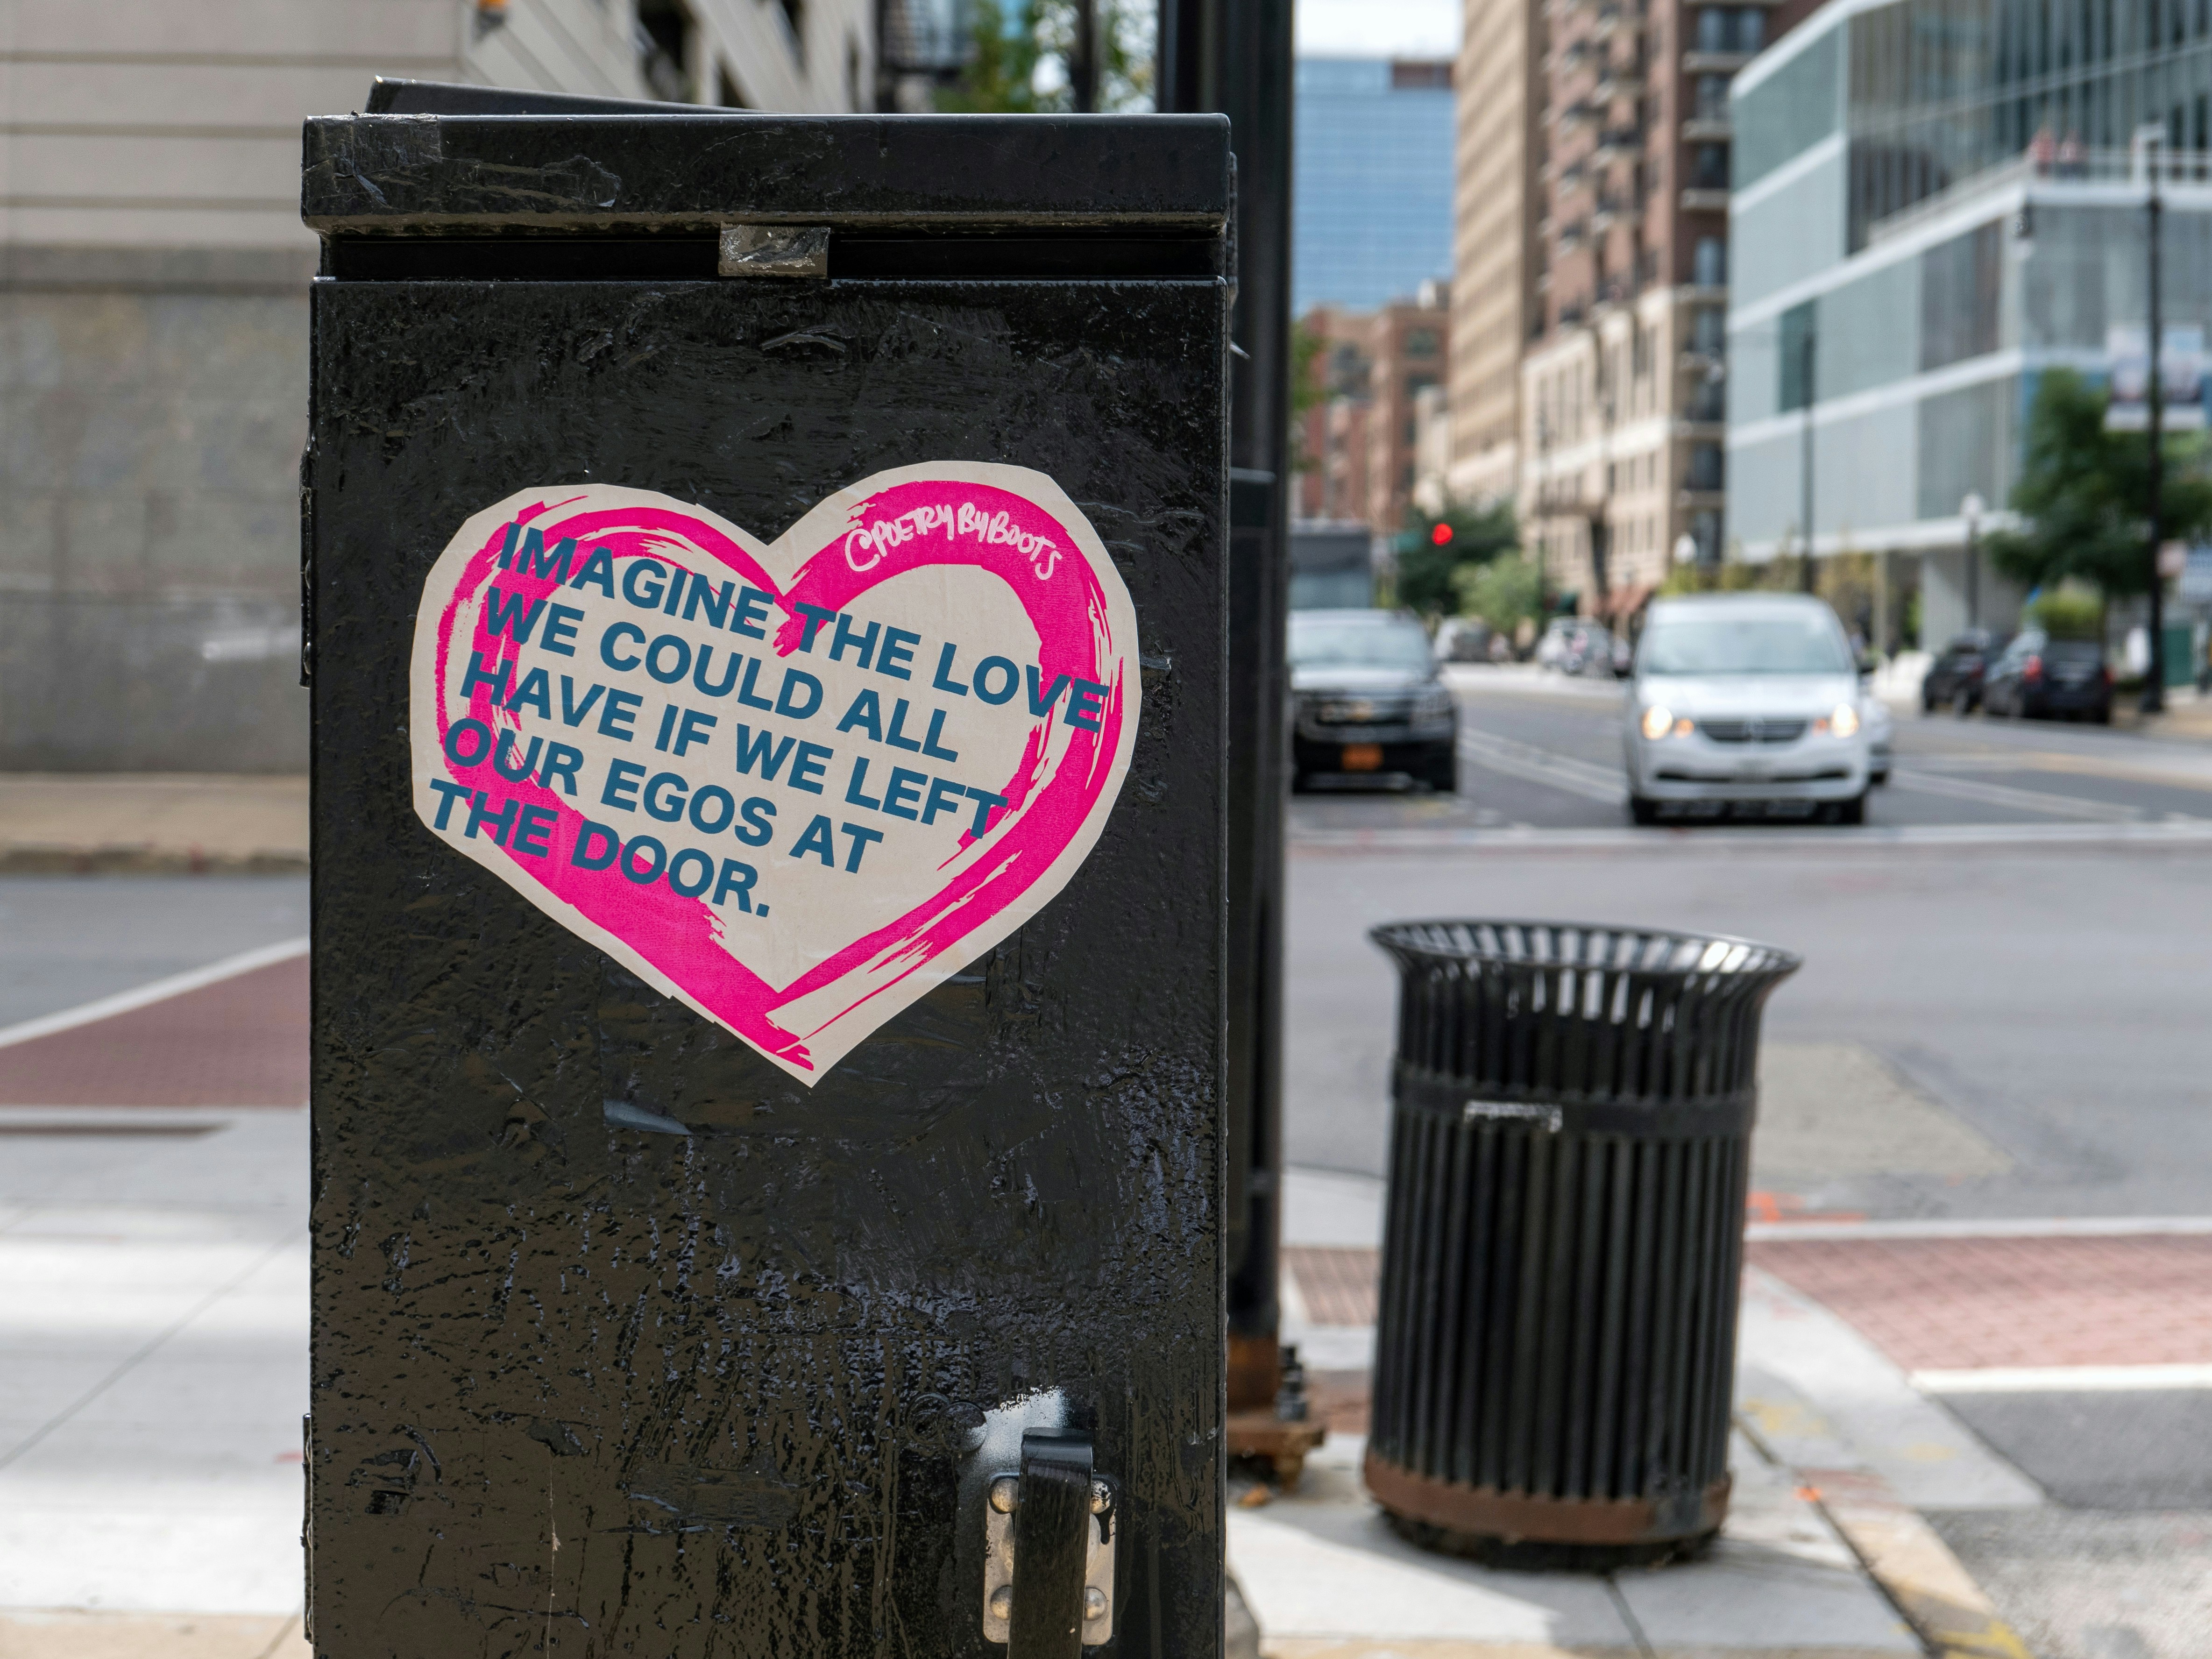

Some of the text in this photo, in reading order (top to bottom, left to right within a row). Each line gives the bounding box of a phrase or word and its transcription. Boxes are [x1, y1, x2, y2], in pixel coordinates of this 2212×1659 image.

[487, 586, 958, 763] WE COULD ALL
[497, 522, 1110, 734] IMAGINE THE LOVE
[445, 717, 884, 874] OUR EGOS AT
[459, 651, 1009, 840] HAVE IF WE LEFT
[429, 778, 770, 918] THE DOOR.
